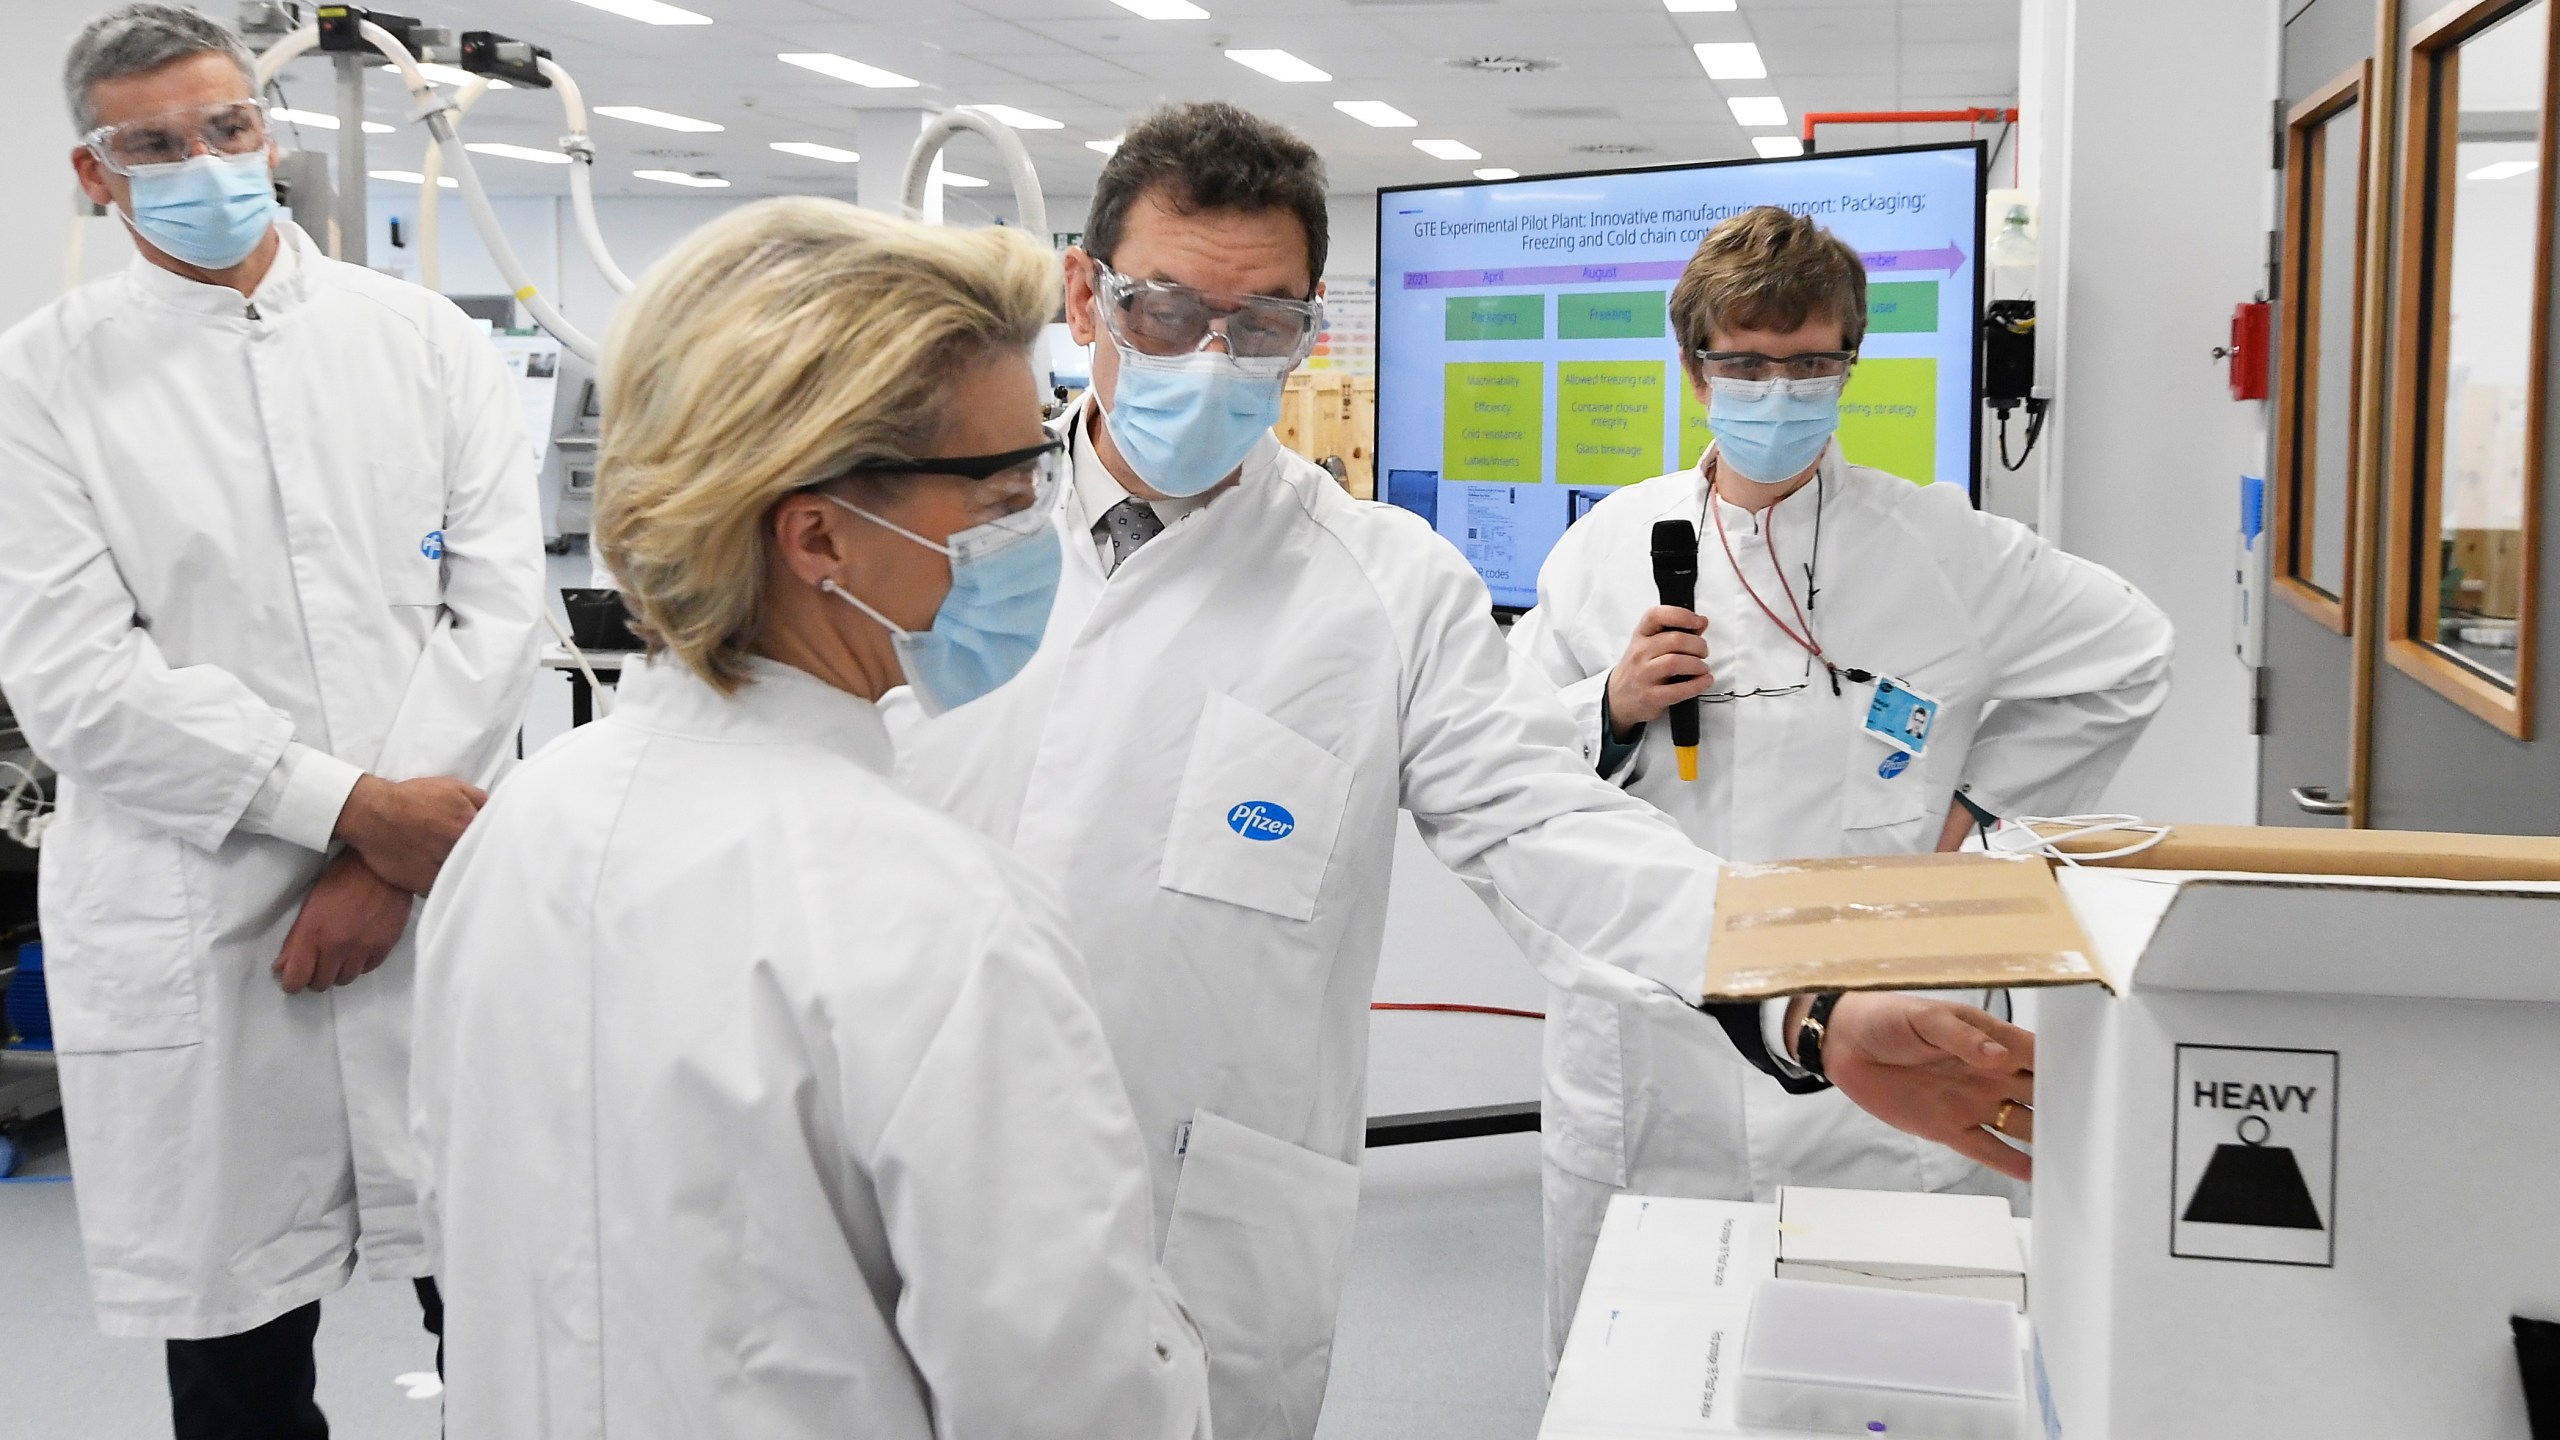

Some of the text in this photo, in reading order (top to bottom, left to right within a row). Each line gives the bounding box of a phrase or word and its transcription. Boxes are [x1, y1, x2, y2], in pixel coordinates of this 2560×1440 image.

[1414, 192, 1926, 240] GTE Experimental Pilot Plant: Innovative manufacturi upport: Packaging;
[1522, 225, 1711, 252] Freezing and Cold chain cont
[1407, 273, 1428, 286] 2021
[1482, 271, 1504, 285] April
[1582, 267, 1617, 281] August
[1471, 303, 1897, 325] Packaging Freezing user
[1564, 374, 1657, 388] Allowed freezing rate
[1474, 402, 1512, 416] Efficiency
[1571, 402, 1649, 413] Container closure
[1839, 403, 1918, 418] ndling strategy
[1591, 416, 1627, 430] integrity
[1462, 428, 1523, 440] Cold resistance
[1575, 443, 1642, 458] Glass breakage
[1485, 567, 1510, 580] codes
[1230, 804, 1293, 837] Pfizer
[2194, 1080, 2317, 1113] HEAVY
